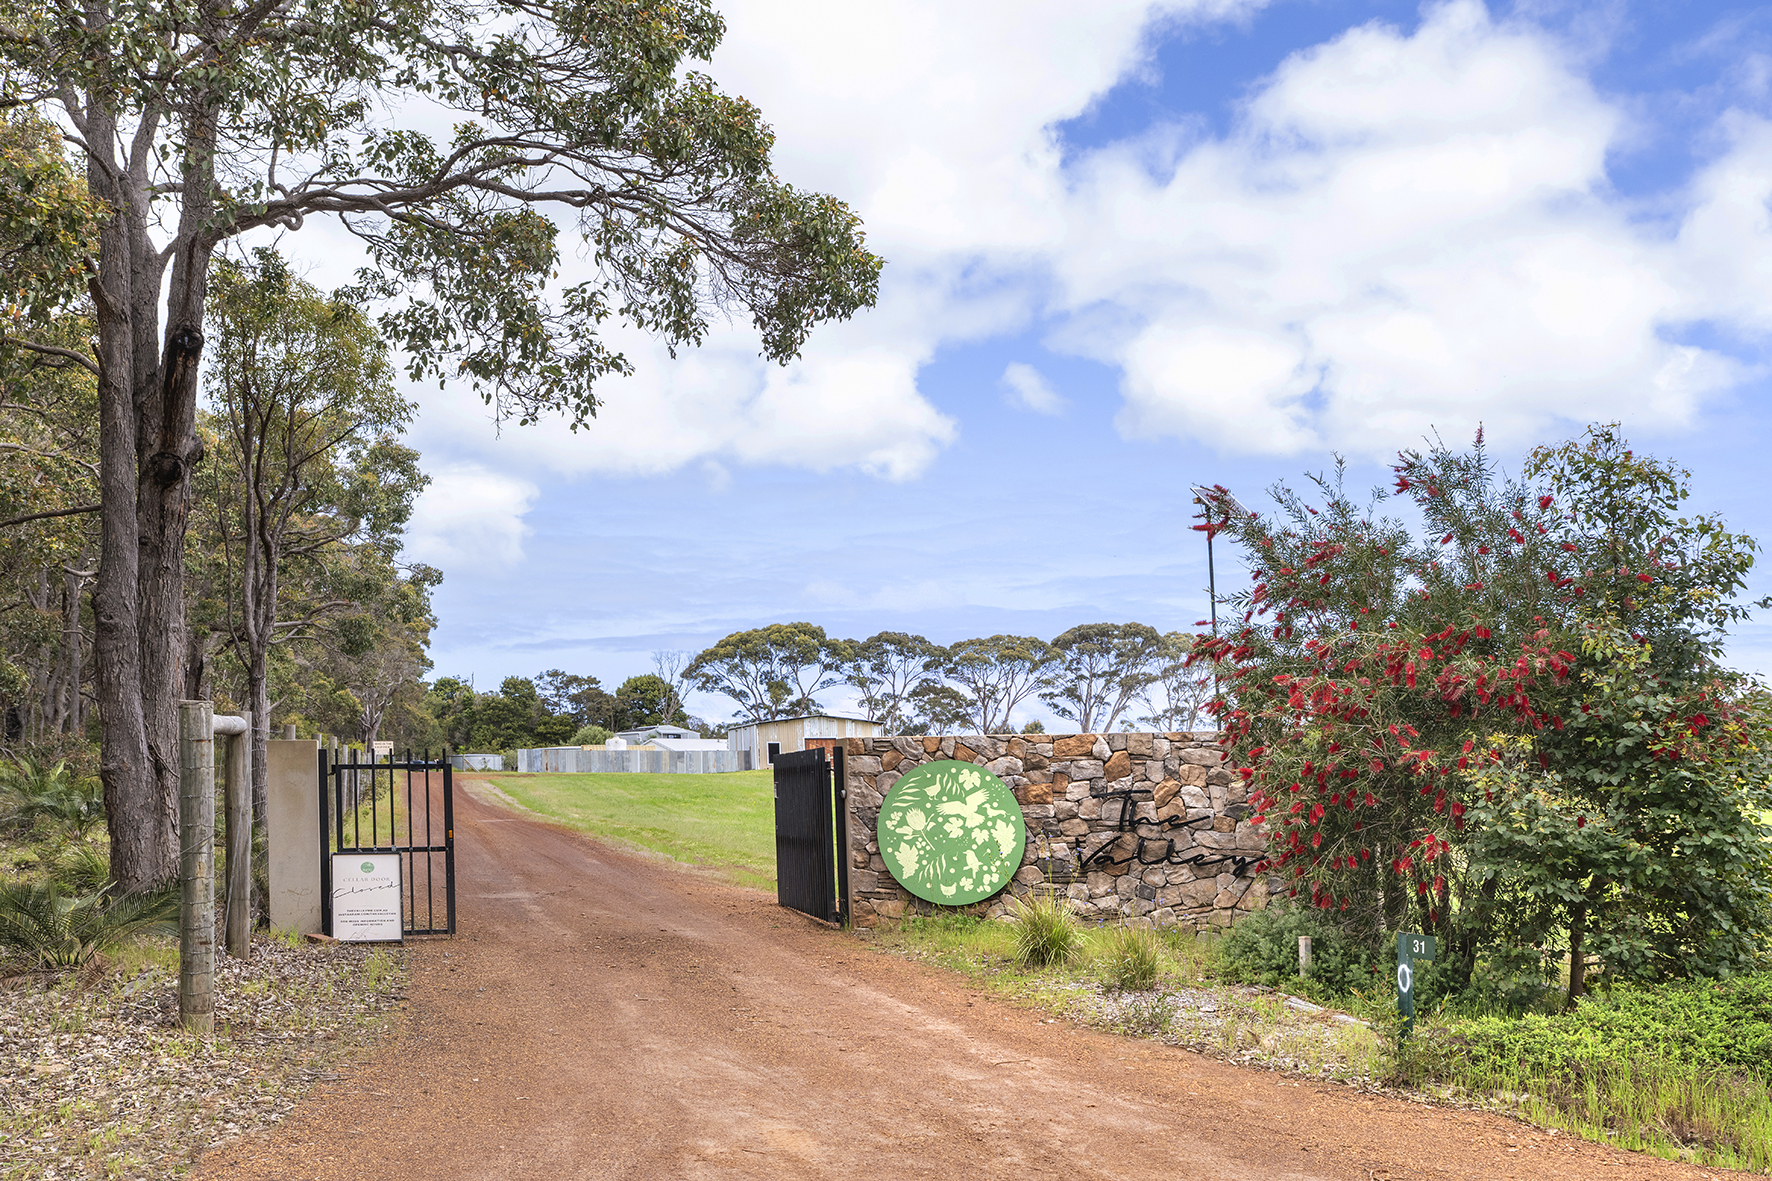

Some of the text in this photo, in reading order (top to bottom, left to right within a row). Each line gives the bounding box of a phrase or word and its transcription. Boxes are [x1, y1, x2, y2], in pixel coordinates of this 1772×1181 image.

[1092, 789, 1210, 832] The
[1075, 835, 1269, 878] Valley
[332, 881, 400, 898] Closed
[1412, 939, 1425, 954] 31
